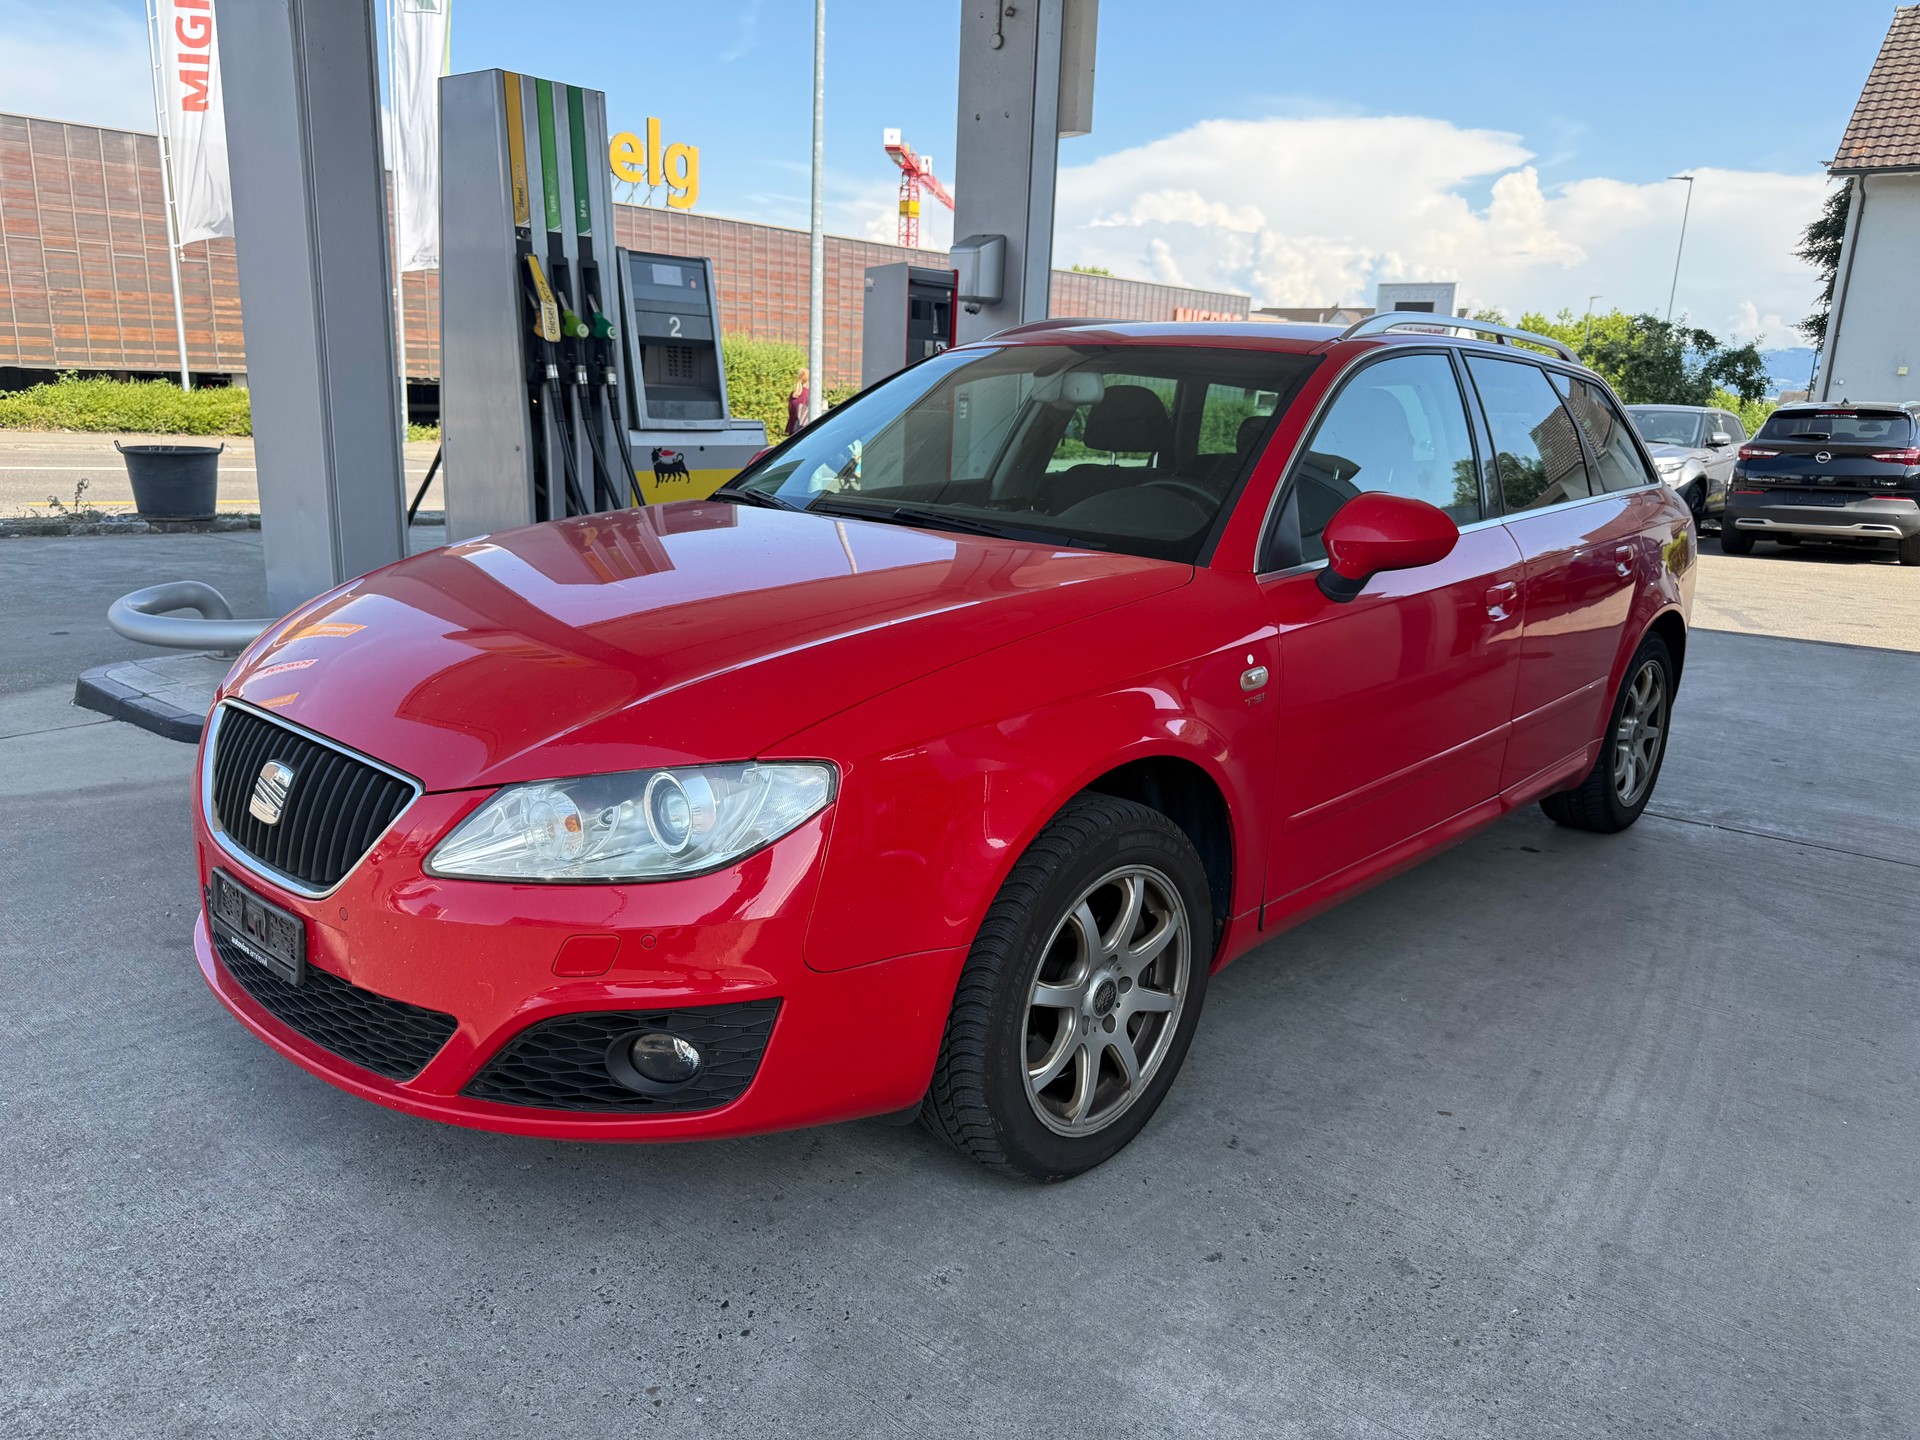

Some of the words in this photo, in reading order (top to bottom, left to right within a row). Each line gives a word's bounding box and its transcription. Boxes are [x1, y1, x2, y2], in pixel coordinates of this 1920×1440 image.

[173, 0, 212, 112] MIG
[609, 116, 700, 210] elg
[545, 307, 557, 335] diesel
[668, 316, 683, 338] 2
[1244, 692, 1267, 708] TSI
